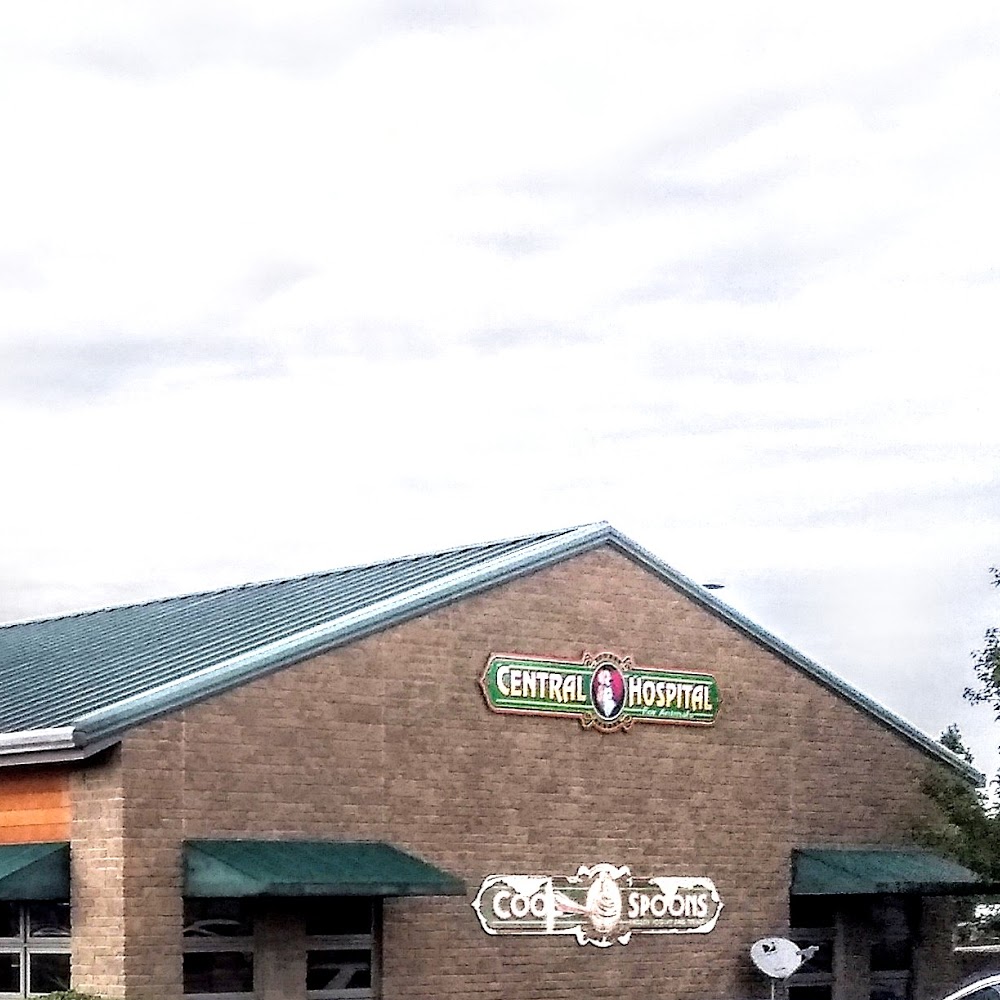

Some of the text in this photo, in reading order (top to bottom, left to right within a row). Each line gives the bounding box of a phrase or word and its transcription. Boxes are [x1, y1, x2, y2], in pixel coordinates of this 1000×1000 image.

[496, 665, 713, 711] CENTRAL HOSPITAL
[628, 891, 708, 918] SPOONS
